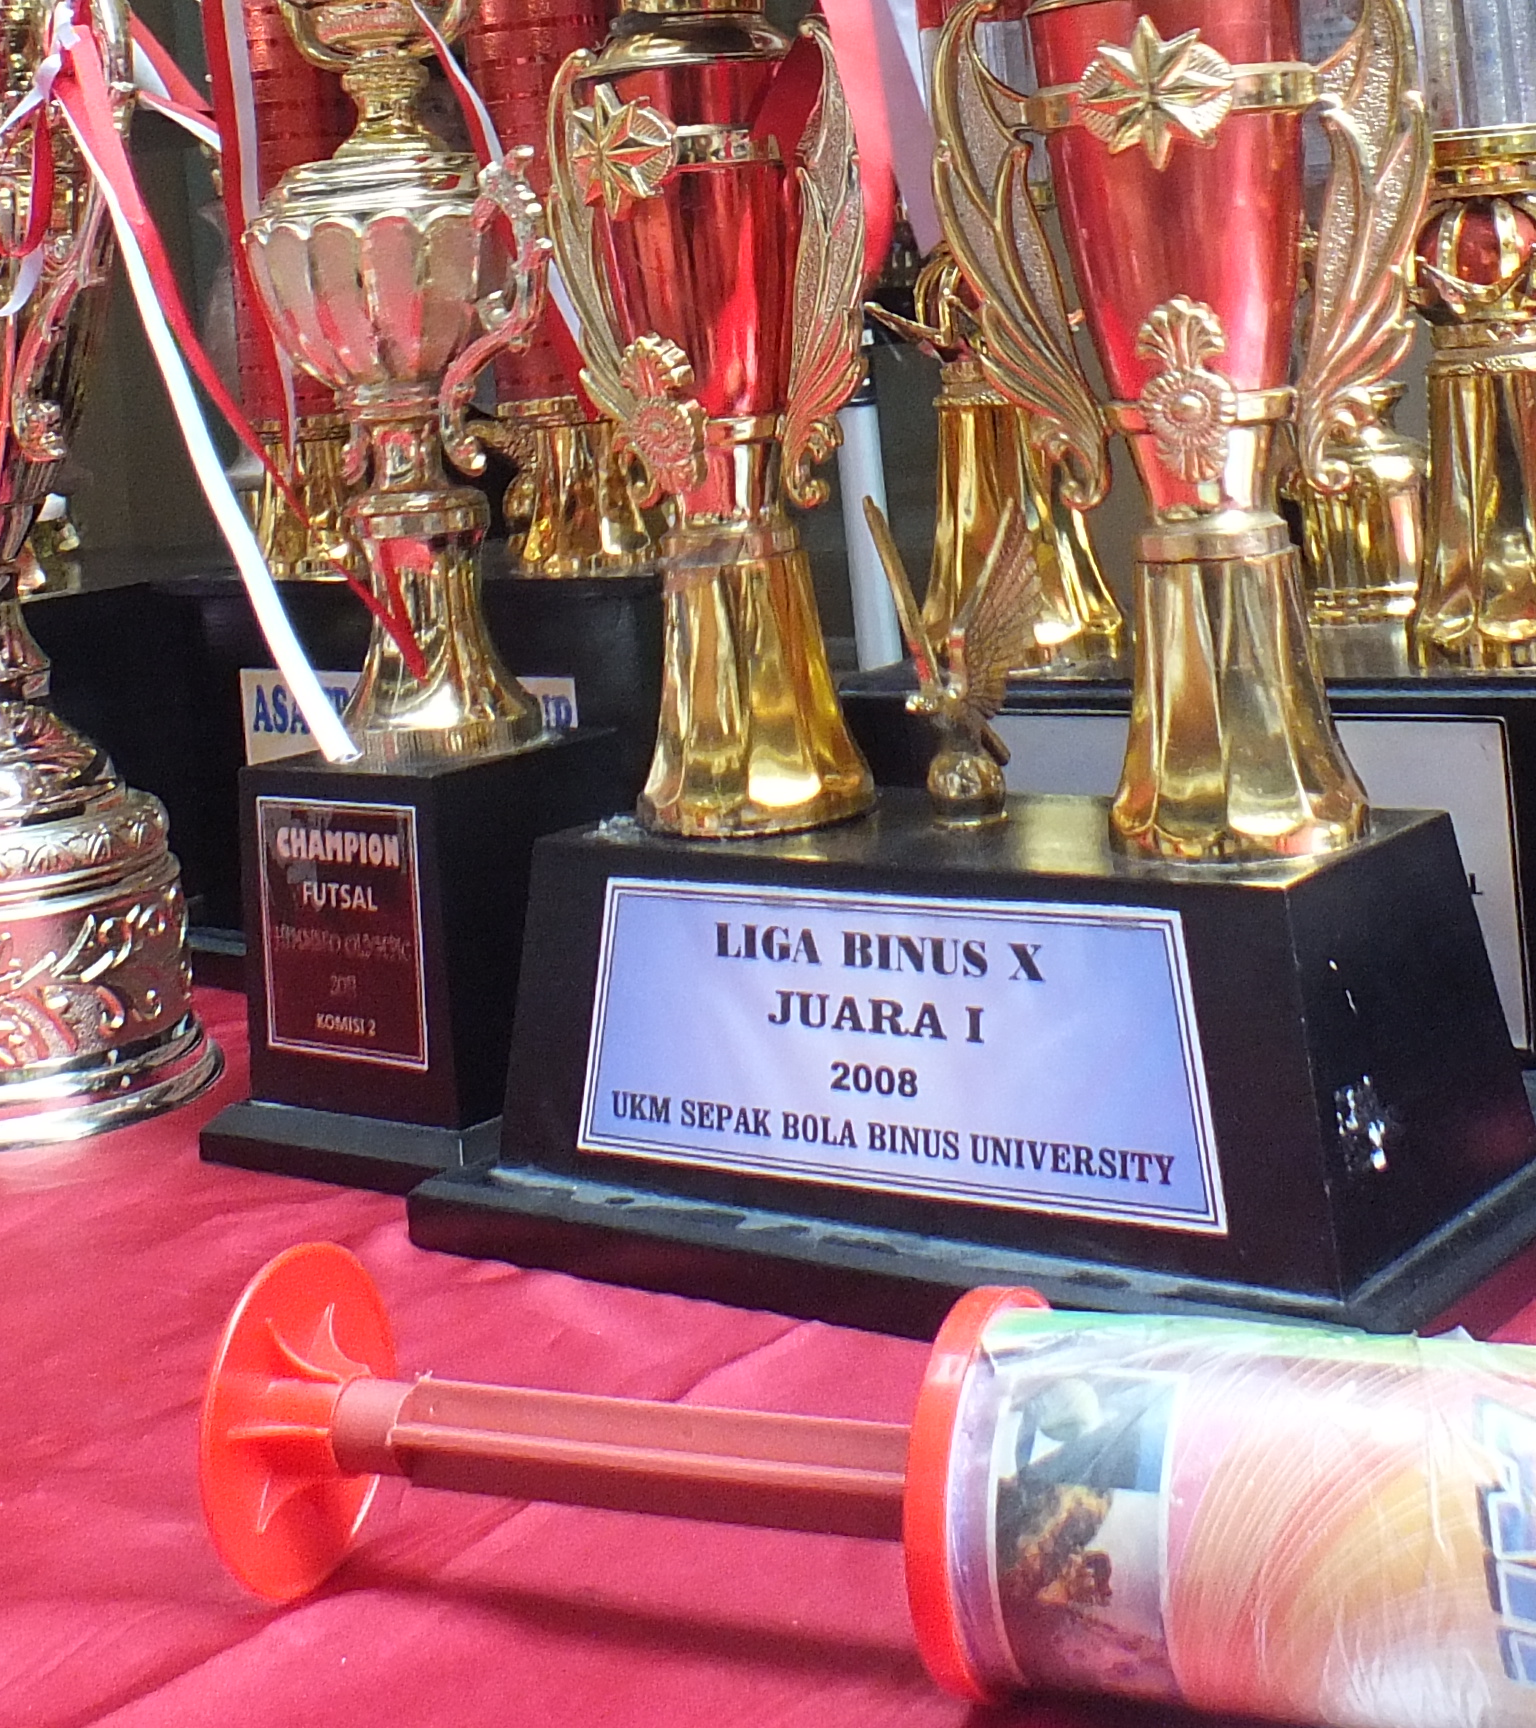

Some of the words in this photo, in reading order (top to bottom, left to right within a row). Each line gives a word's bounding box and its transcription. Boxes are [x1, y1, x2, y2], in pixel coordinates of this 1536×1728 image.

[276, 826, 400, 867] CHAMPION
[302, 881, 378, 912] FUTSAL
[715, 922, 822, 964] LIGA
[841, 930, 989, 978] BINUS
[1006, 943, 1045, 982] X
[367, 1019, 376, 1037] 2
[767, 989, 948, 1041] JUARA
[964, 1005, 985, 1043] I
[830, 1060, 918, 1097] 2008
[611, 1091, 672, 1123] UKM
[680, 1099, 771, 1137] SEPAK
[782, 1112, 858, 1148] BOLA
[868, 1122, 960, 1161] BINUS
[970, 1133, 1175, 1185] UNIVERSITY
